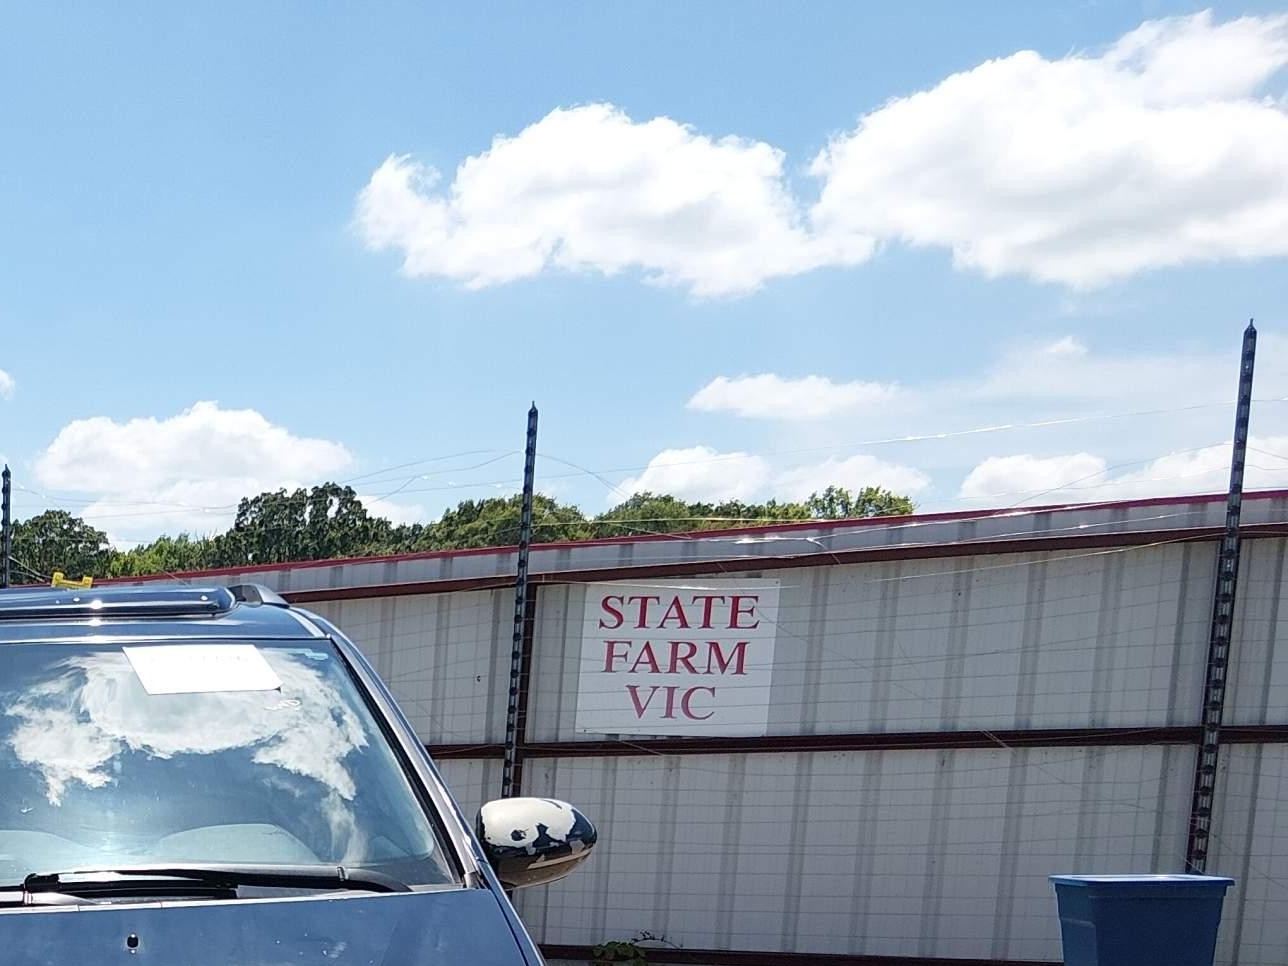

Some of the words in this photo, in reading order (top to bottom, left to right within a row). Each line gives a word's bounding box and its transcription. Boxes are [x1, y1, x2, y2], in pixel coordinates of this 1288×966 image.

[598, 595, 760, 630] STATE
[601, 640, 750, 675] FARM
[625, 684, 716, 720] VIC
